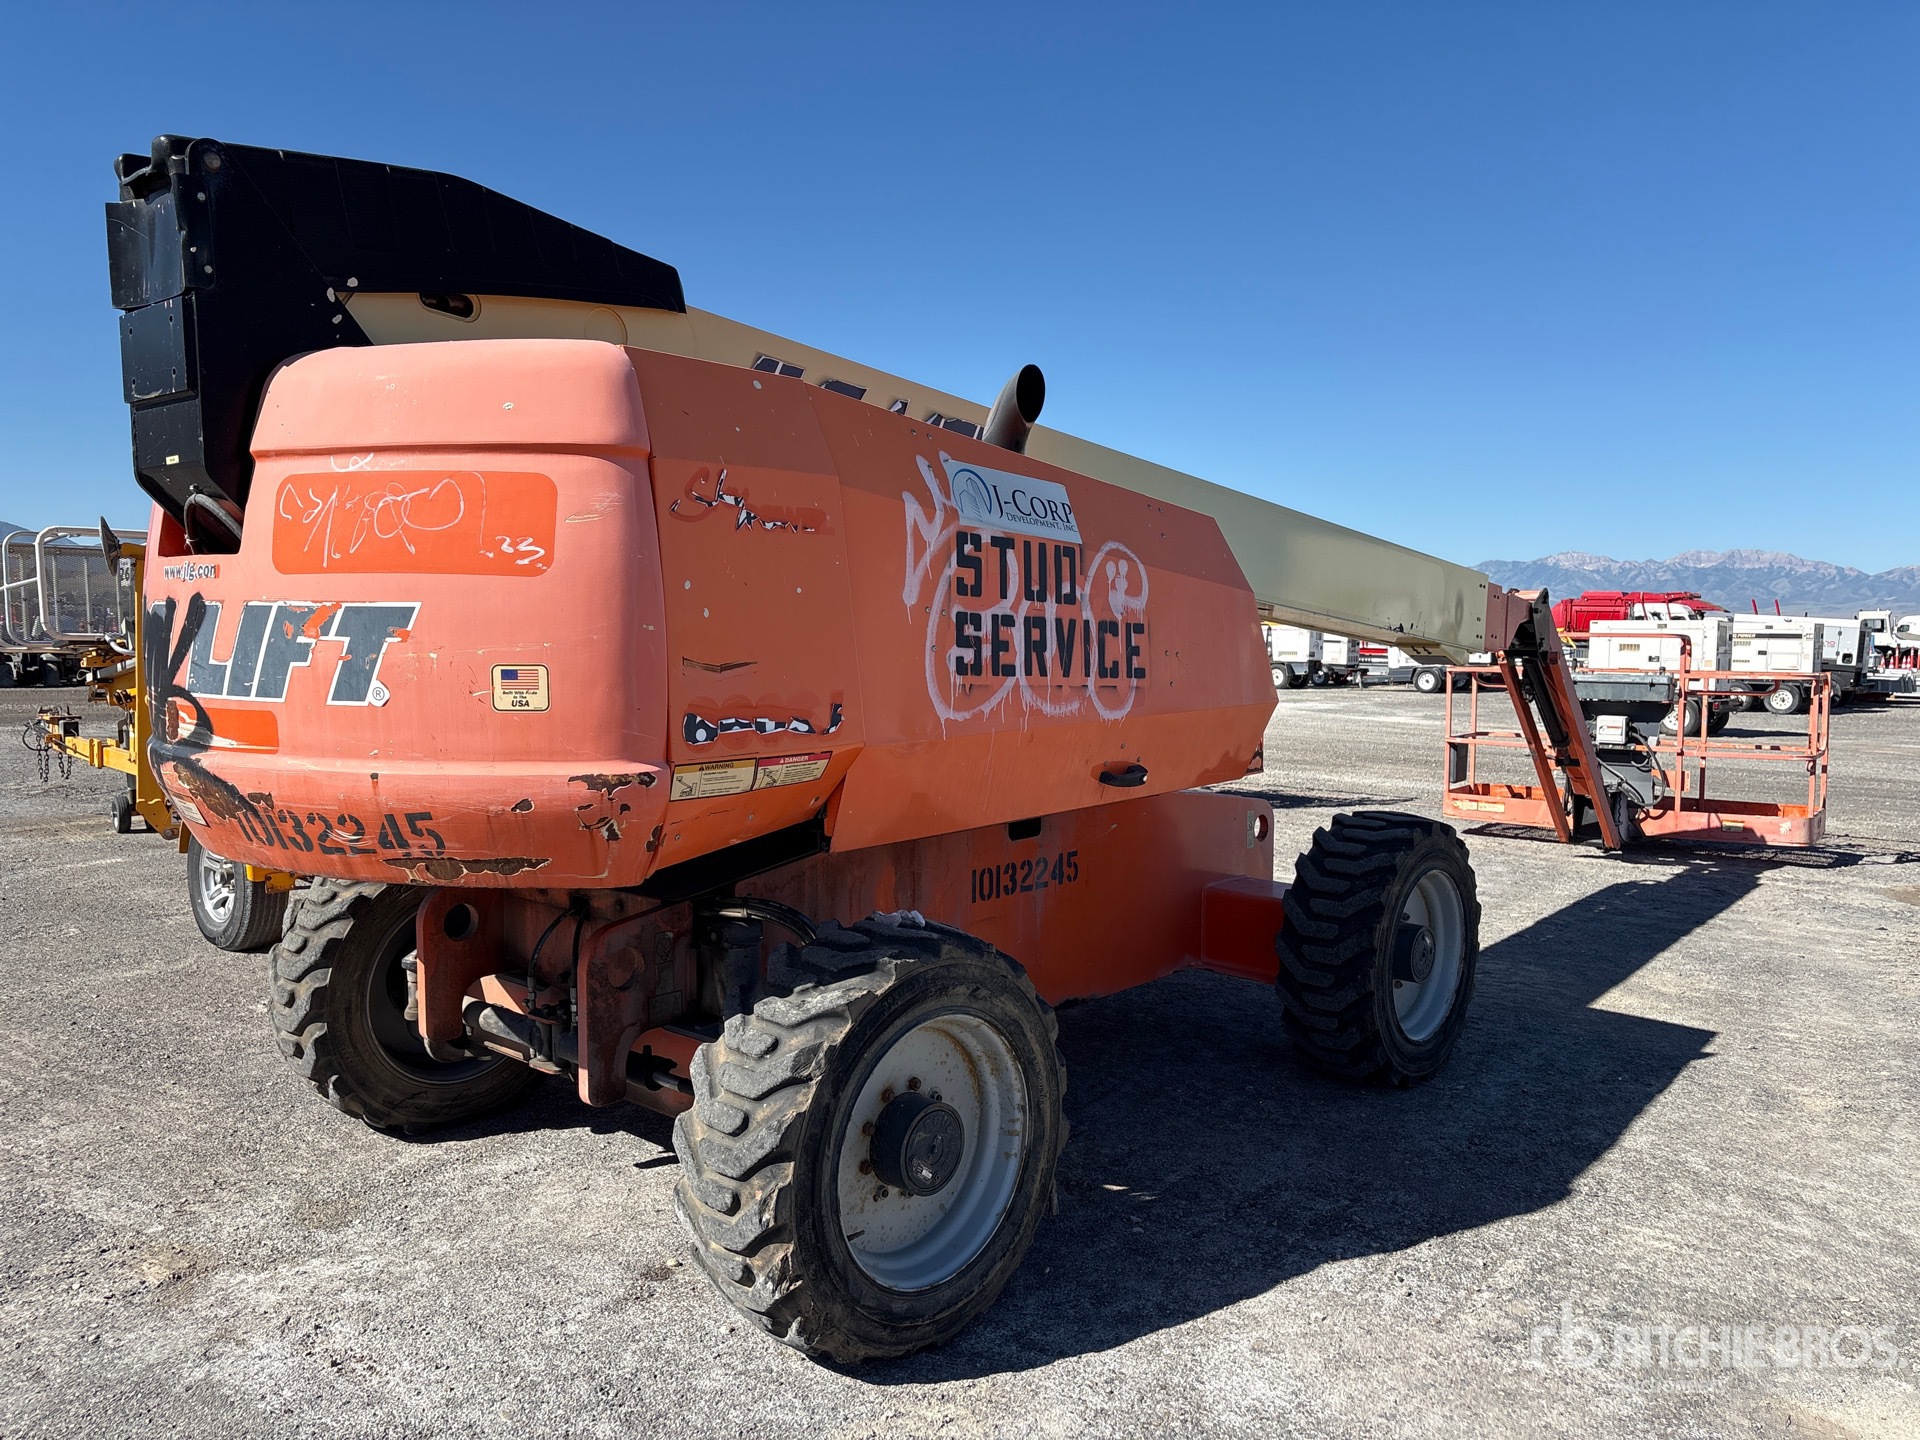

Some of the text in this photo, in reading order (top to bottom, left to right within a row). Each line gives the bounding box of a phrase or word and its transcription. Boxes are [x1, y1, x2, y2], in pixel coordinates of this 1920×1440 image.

[990, 484, 1072, 524] J-CORP
[956, 531, 1076, 605] STUD
[955, 611, 1146, 679] SERVICE
[511, 700, 530, 708] USA
[704, 763, 735, 771] WARNING
[784, 756, 809, 764] DANGER
[236, 809, 446, 858] 10132245
[971, 850, 1079, 904] 10132245
